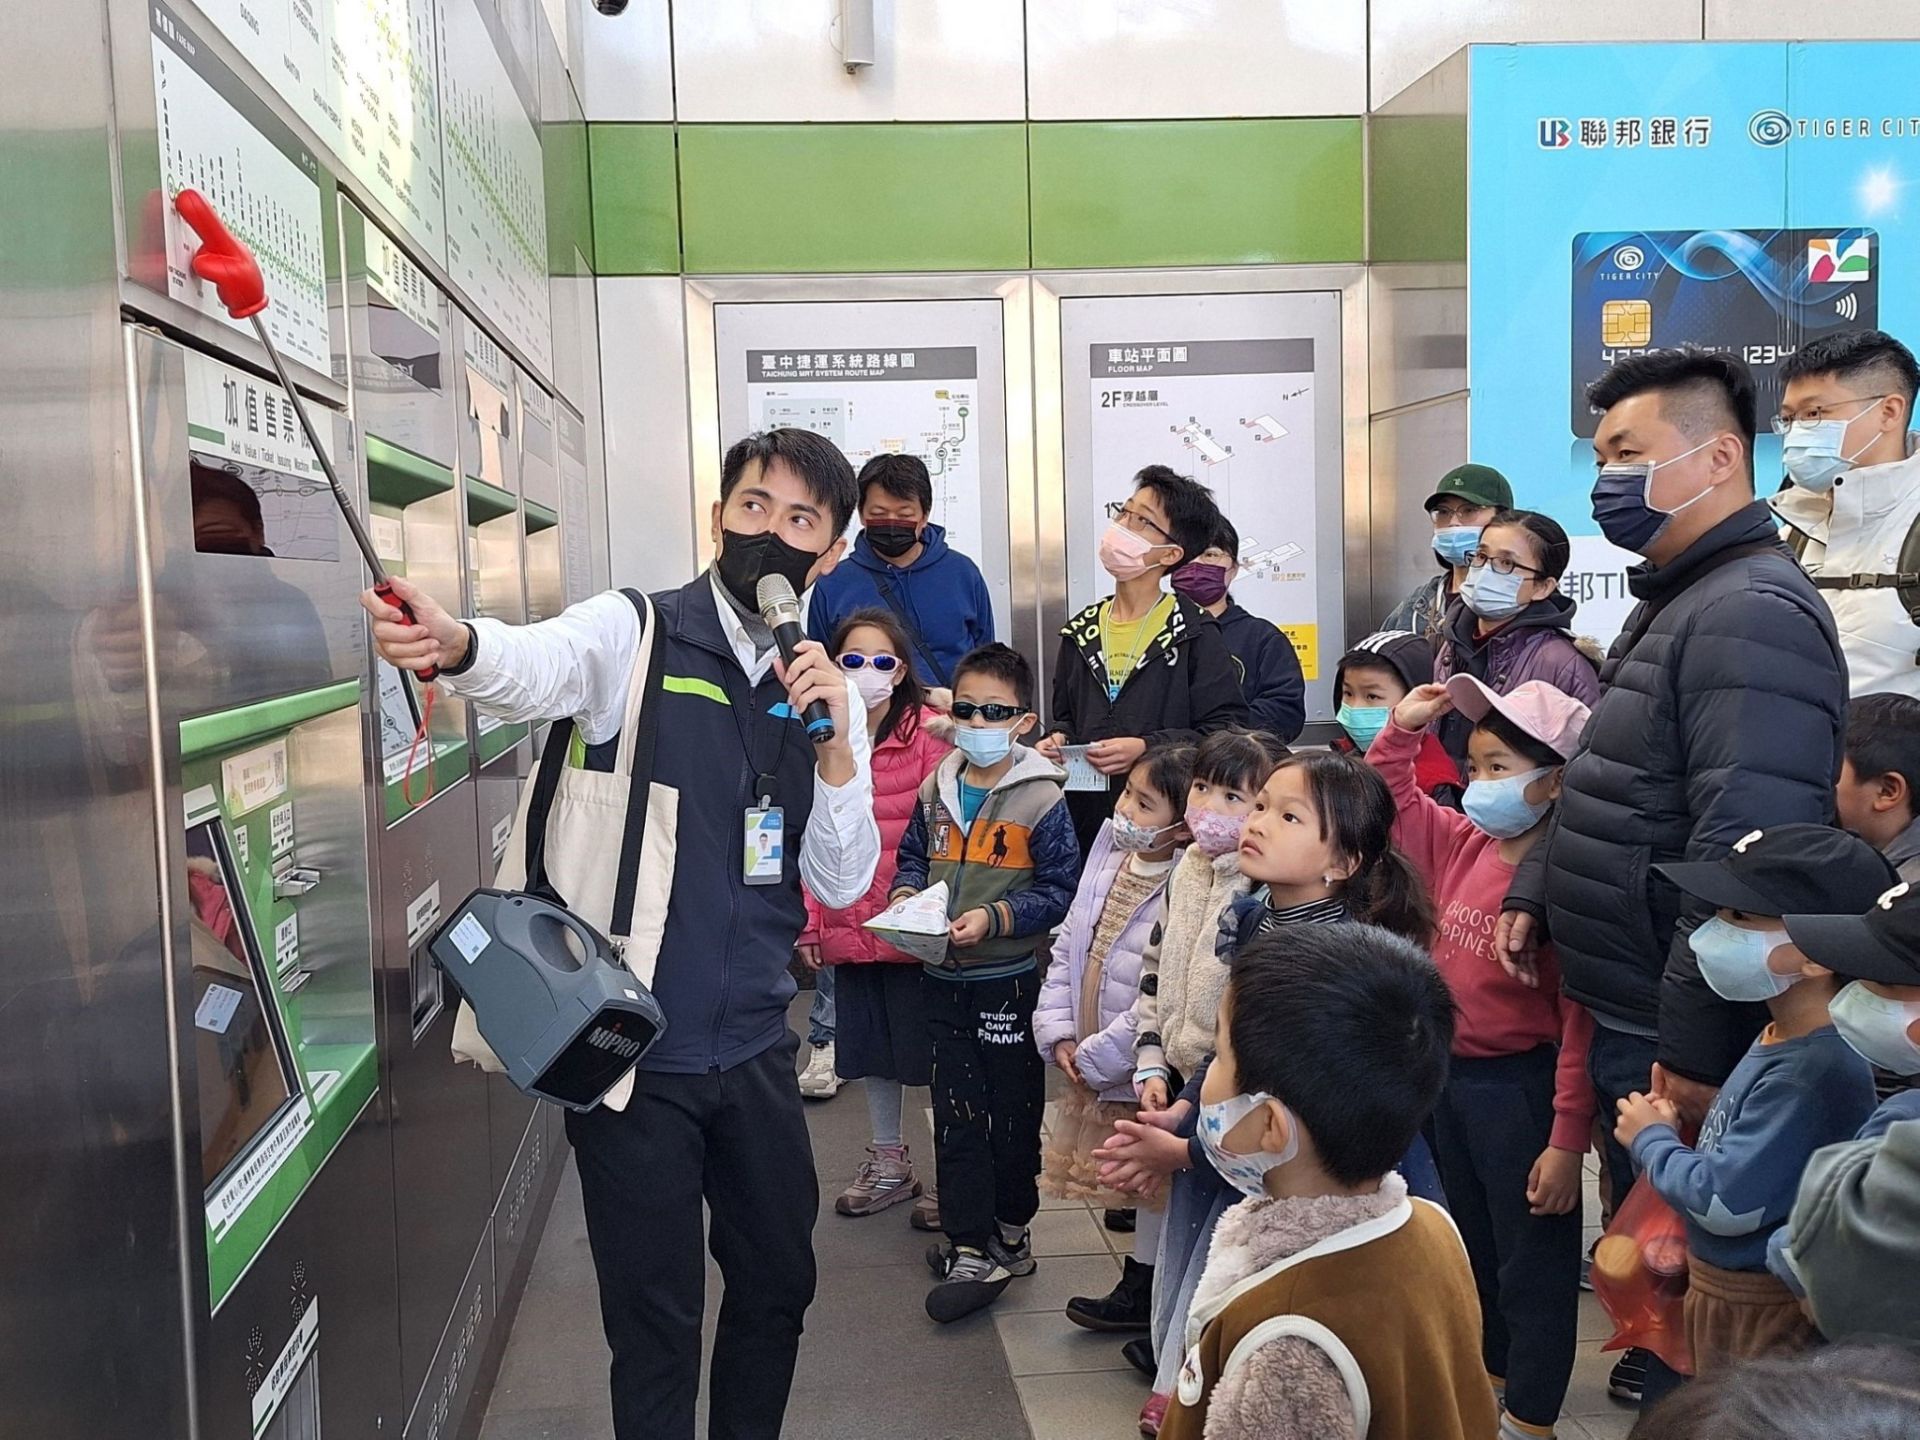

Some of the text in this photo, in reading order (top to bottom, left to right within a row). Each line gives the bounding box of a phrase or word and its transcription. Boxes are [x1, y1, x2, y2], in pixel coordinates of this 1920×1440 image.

[1580, 118, 1709, 146] 聯邦銀行
[1798, 120, 1869, 136] TIGER
[1600, 272, 1659, 281] TIGER CITY
[761, 352, 915, 370] 臺中捷運系統路線圖
[1108, 346, 1188, 363] 車站平面圖
[761, 370, 798, 378] TAICHUNG
[815, 369, 844, 377] SYSTEM
[845, 369, 868, 377] ROUTE
[869, 369, 885, 377] MAP
[1108, 365, 1135, 373] FLOOR
[1101, 390, 1158, 408] 2F 穿越層
[231, 440, 241, 454] Add
[244, 444, 257, 459] Value
[261, 447, 275, 463] Ticket
[294, 457, 309, 473] Machine
[1446, 899, 1497, 937] CHOOS
[979, 1011, 1018, 1022] STUDIO
[985, 1022, 1012, 1032] CAVE
[586, 1026, 641, 1058] MIPRO
[977, 1028, 1025, 1045] FRANK
